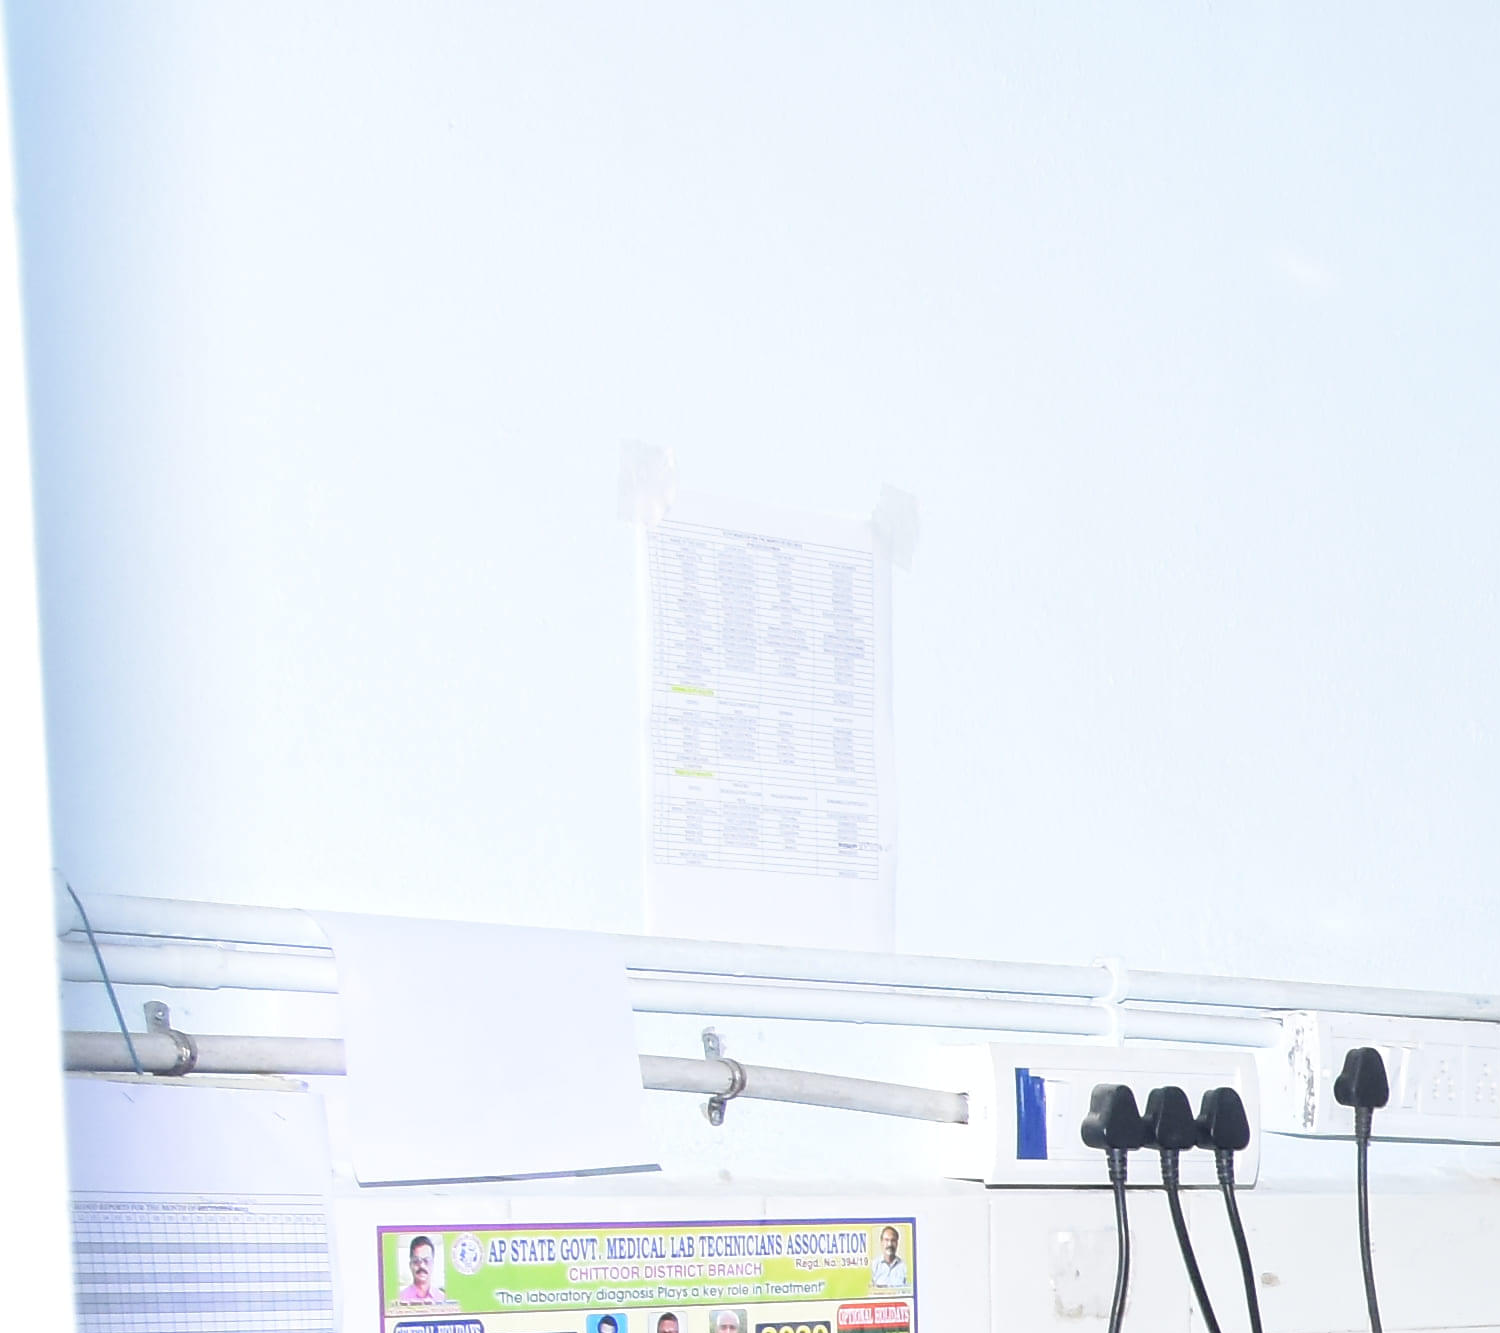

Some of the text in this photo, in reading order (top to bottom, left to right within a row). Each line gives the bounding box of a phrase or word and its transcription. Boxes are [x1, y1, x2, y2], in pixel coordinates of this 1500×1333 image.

[488, 1232, 867, 1262] AP STATE GOVT. MEDICAL LAB TECHNICIANS ASSOCIATION
[569, 1262, 762, 1281] CHITTOOR DISTRICT BRANCH
[526, 1289, 592, 1305] laboratory
[596, 1287, 654, 1303] diagnosis
[658, 1286, 688, 1300] Plays
[692, 1287, 699, 1296] a
[703, 1284, 724, 1298] key
[727, 1283, 749, 1295] role
[752, 1283, 762, 1294] in
